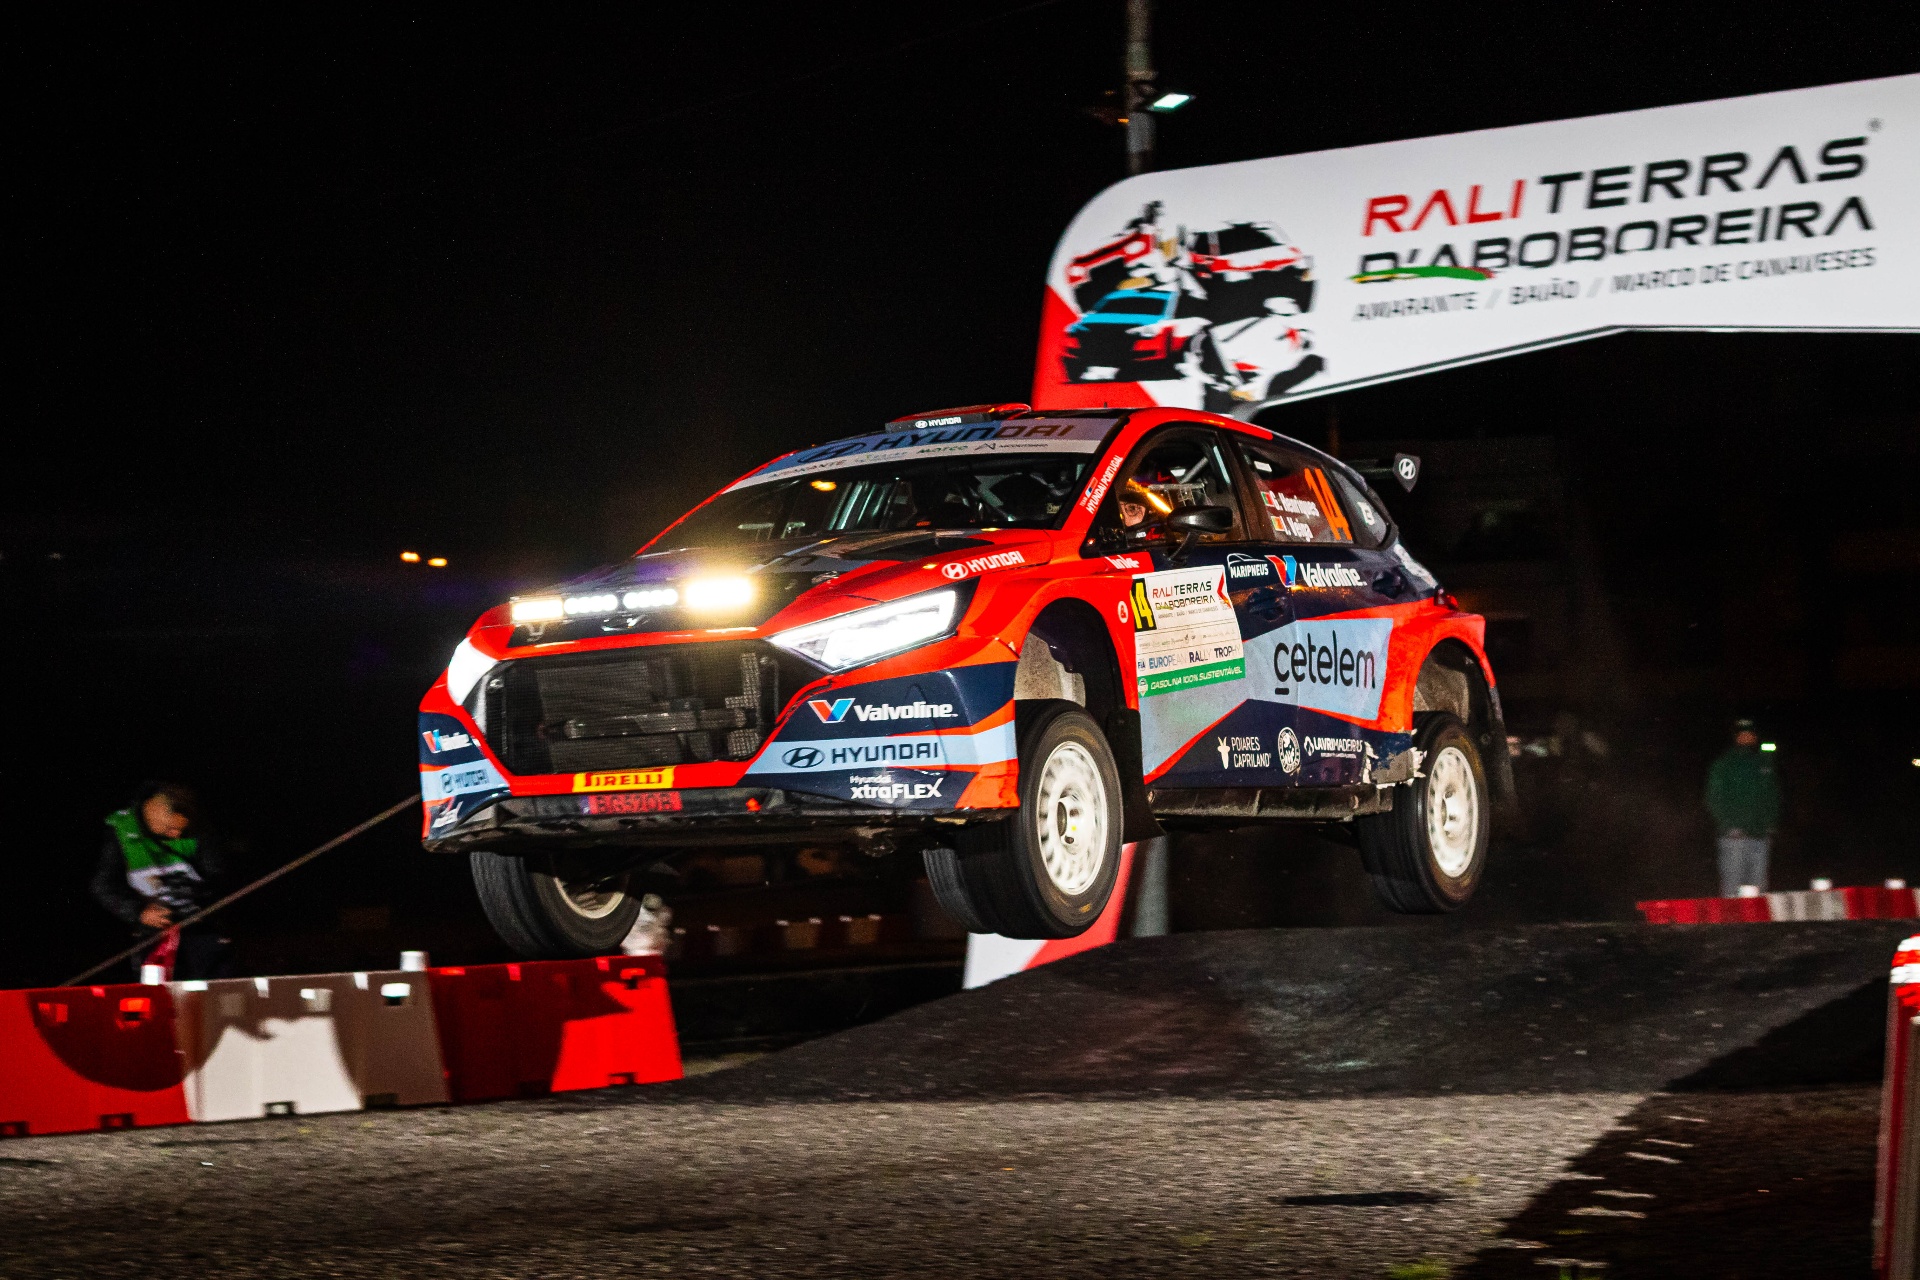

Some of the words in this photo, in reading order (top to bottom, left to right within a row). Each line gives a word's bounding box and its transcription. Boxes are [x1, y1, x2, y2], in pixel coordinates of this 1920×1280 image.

[1362, 178, 1526, 236] RALI
[1538, 136, 1868, 214] TERRAS
[1356, 196, 1874, 282] D'ABOBOREIRA
[1611, 267, 1696, 293] MARCO
[1699, 263, 1731, 284] DE
[929, 417, 961, 426] HYUNDAI
[872, 424, 1074, 451] HYUNDAI
[1086, 482, 1108, 514] HYUNDAI
[1304, 468, 1352, 540] 14
[966, 551, 1025, 572] HYUNDAI
[1230, 564, 1269, 578] MARIPNEUS
[1152, 587, 1173, 598] RALI
[1174, 581, 1212, 595] TERRAS
[1129, 583, 1154, 629] 14
[1273, 630, 1376, 693] cetelem
[1151, 676, 1181, 690] GASOLINA
[1183, 674, 1198, 684] 100%
[832, 742, 938, 764] HYUNDAI
[1231, 736, 1260, 751] POIARES
[583, 769, 664, 788] PIRELLI
[850, 774, 892, 785] Hyundai
[850, 777, 944, 799] xtraFLEX
